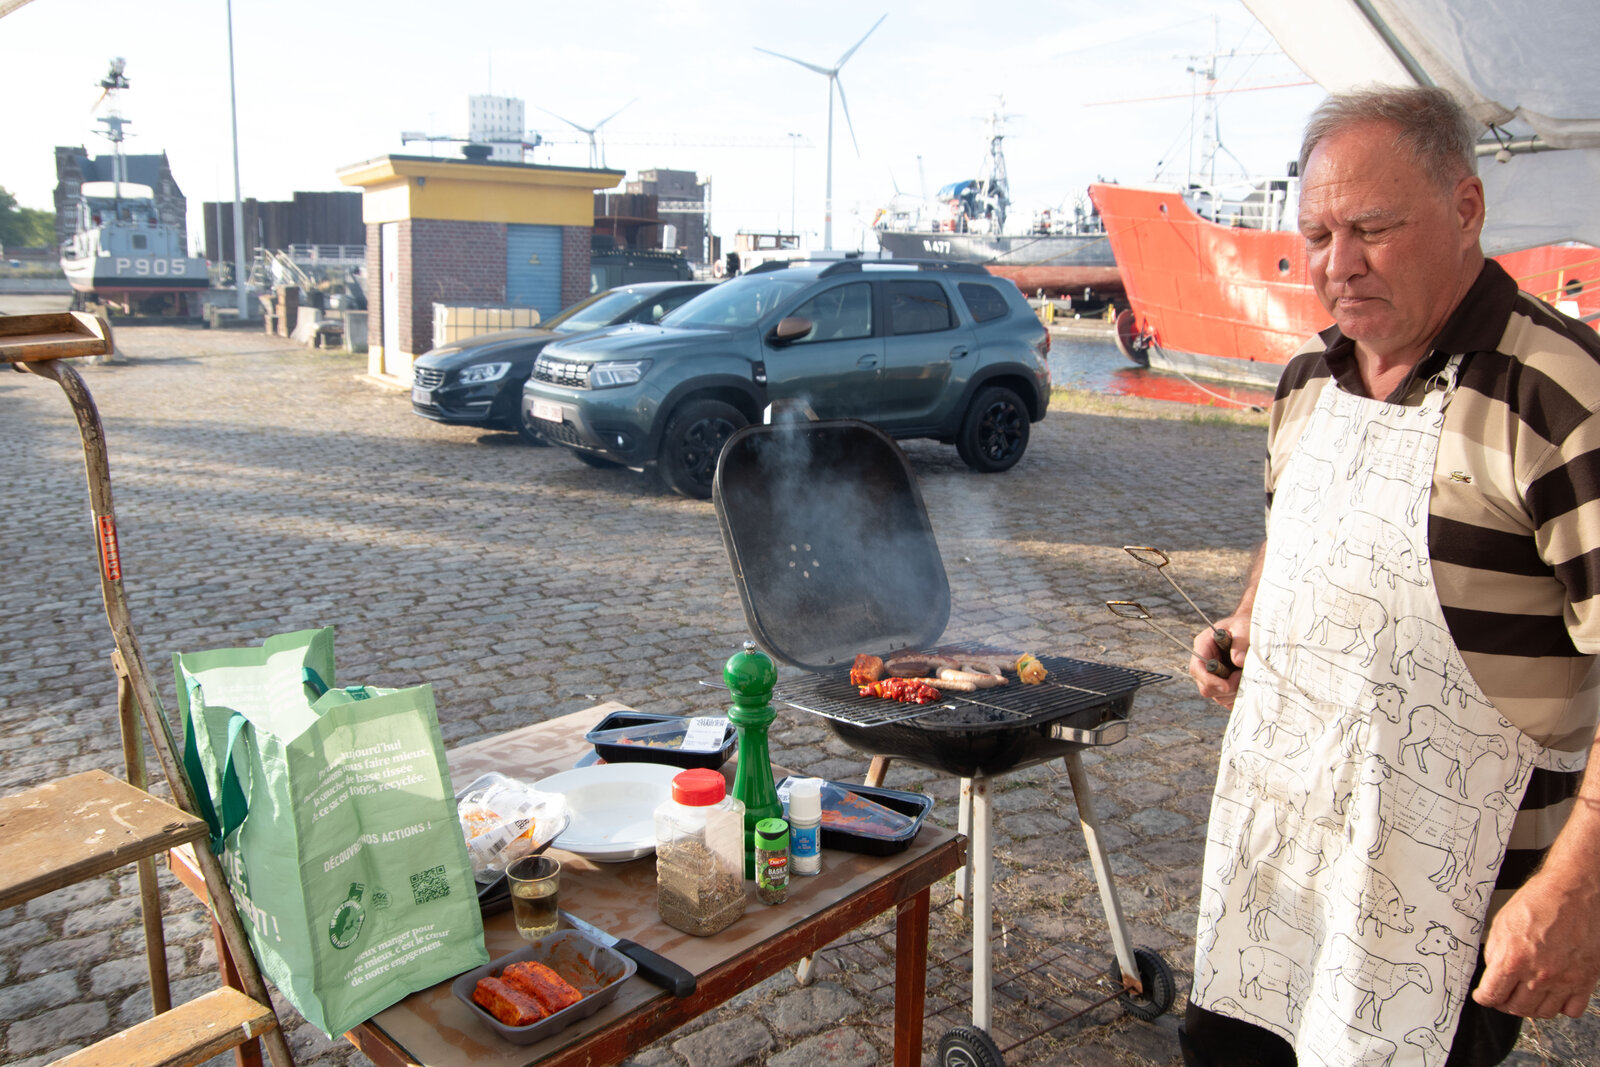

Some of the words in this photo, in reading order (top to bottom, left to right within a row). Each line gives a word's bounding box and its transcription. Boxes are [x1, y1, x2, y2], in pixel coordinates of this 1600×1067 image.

[116, 258, 185, 275] P905
[364, 756, 391, 770] faire
[356, 771, 381, 783] base
[349, 783, 377, 796] 100%
[381, 822, 426, 843] ACTIONS
[378, 931, 411, 951] manger
[412, 924, 435, 941] pour
[351, 975, 364, 988] de
[364, 963, 390, 980] notre
